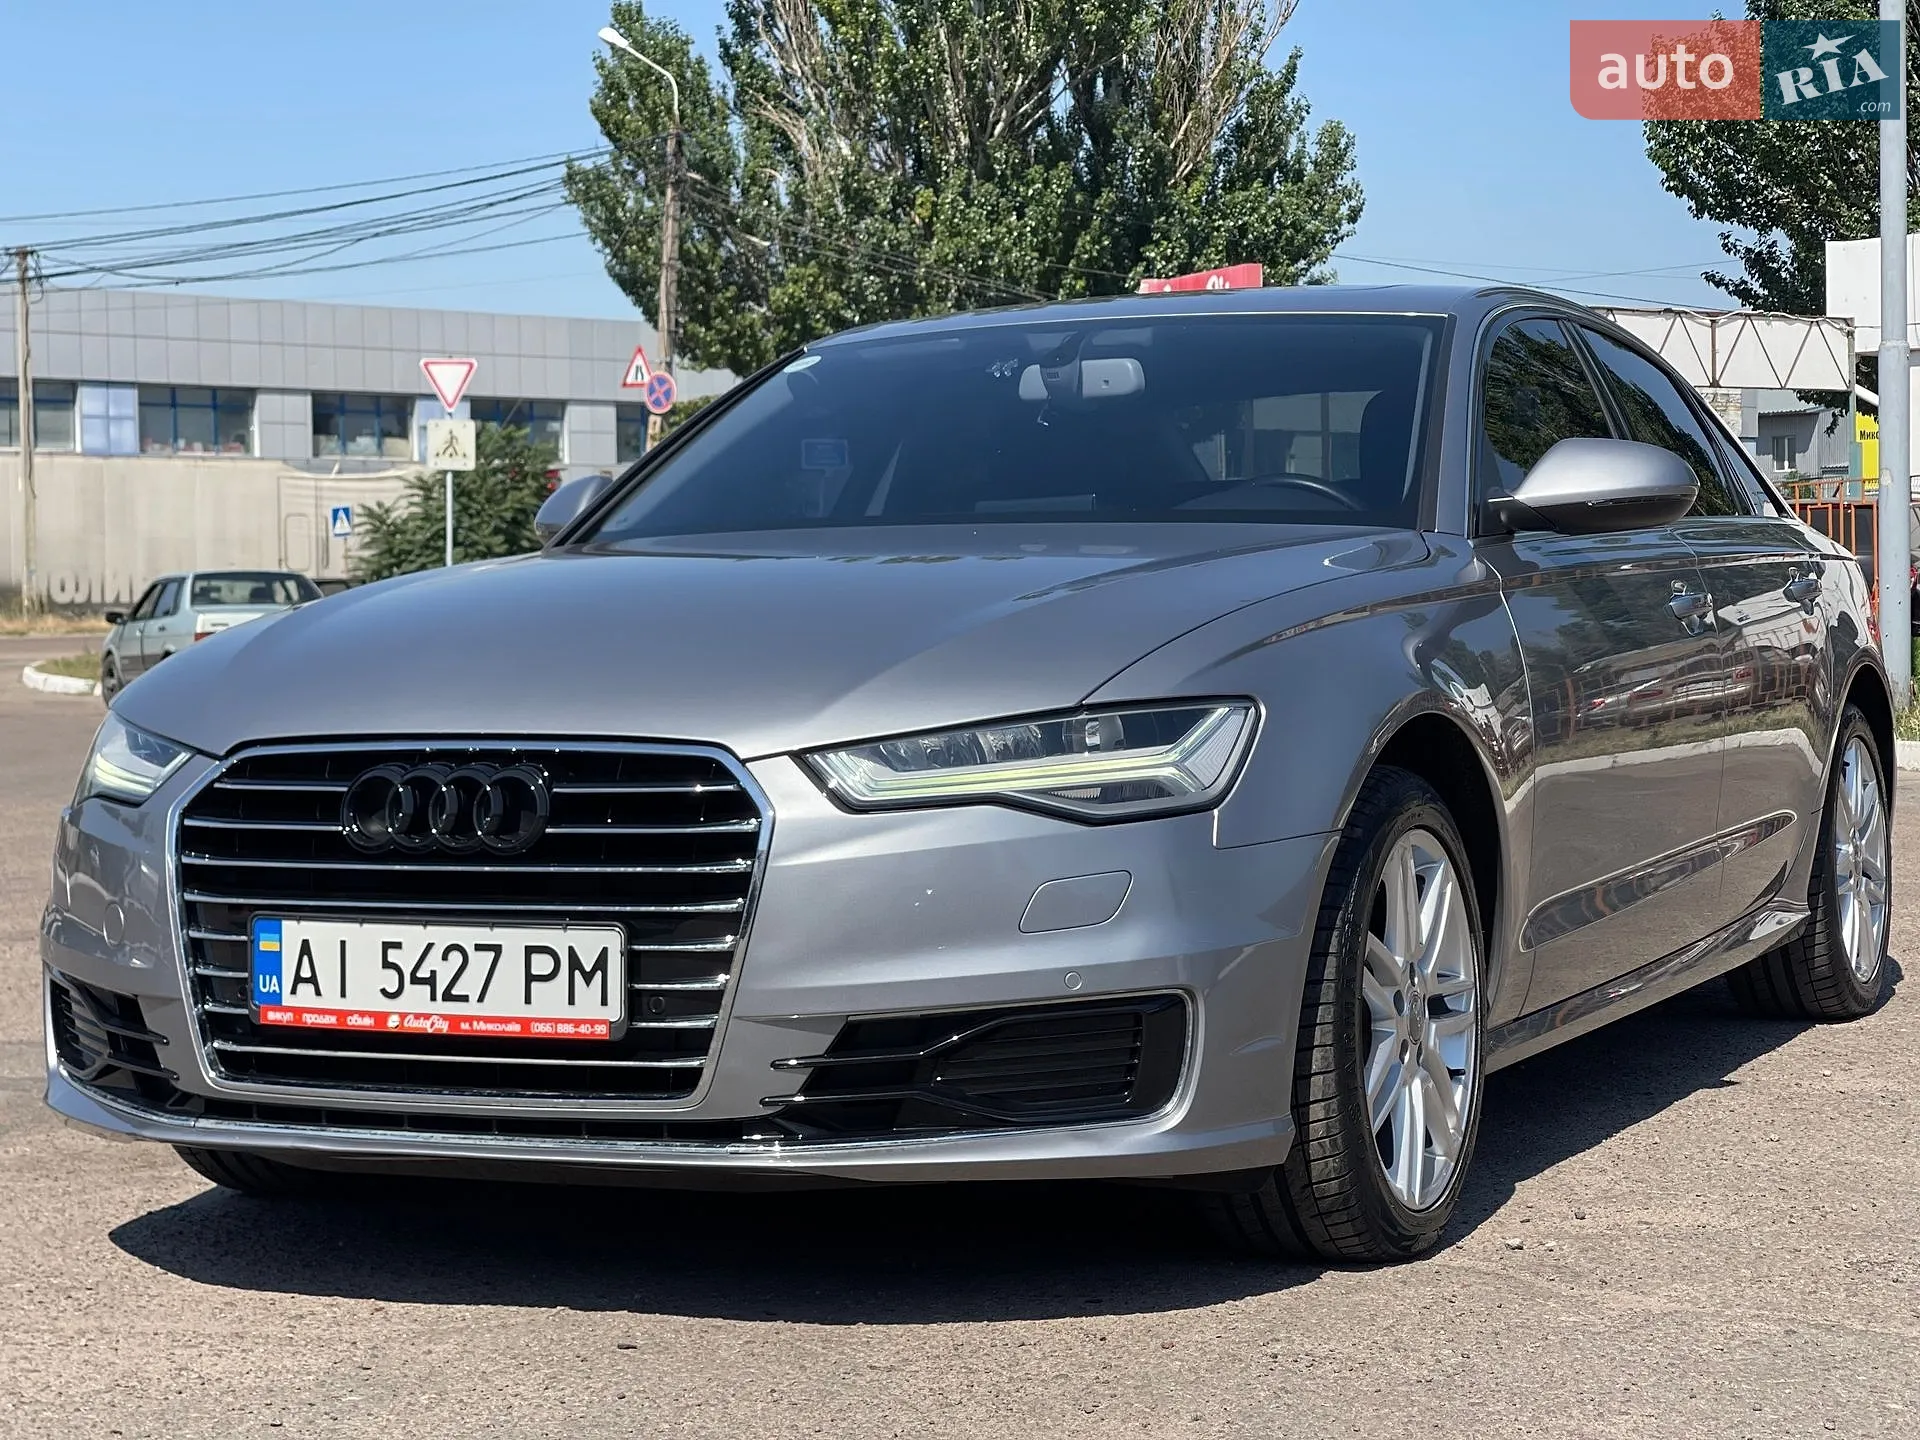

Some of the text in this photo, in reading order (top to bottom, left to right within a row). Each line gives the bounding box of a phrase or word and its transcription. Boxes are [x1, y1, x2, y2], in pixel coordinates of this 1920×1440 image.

[259, 974, 281, 994] UA
[379, 940, 503, 1003] 5427
[524, 944, 609, 1006] PM
